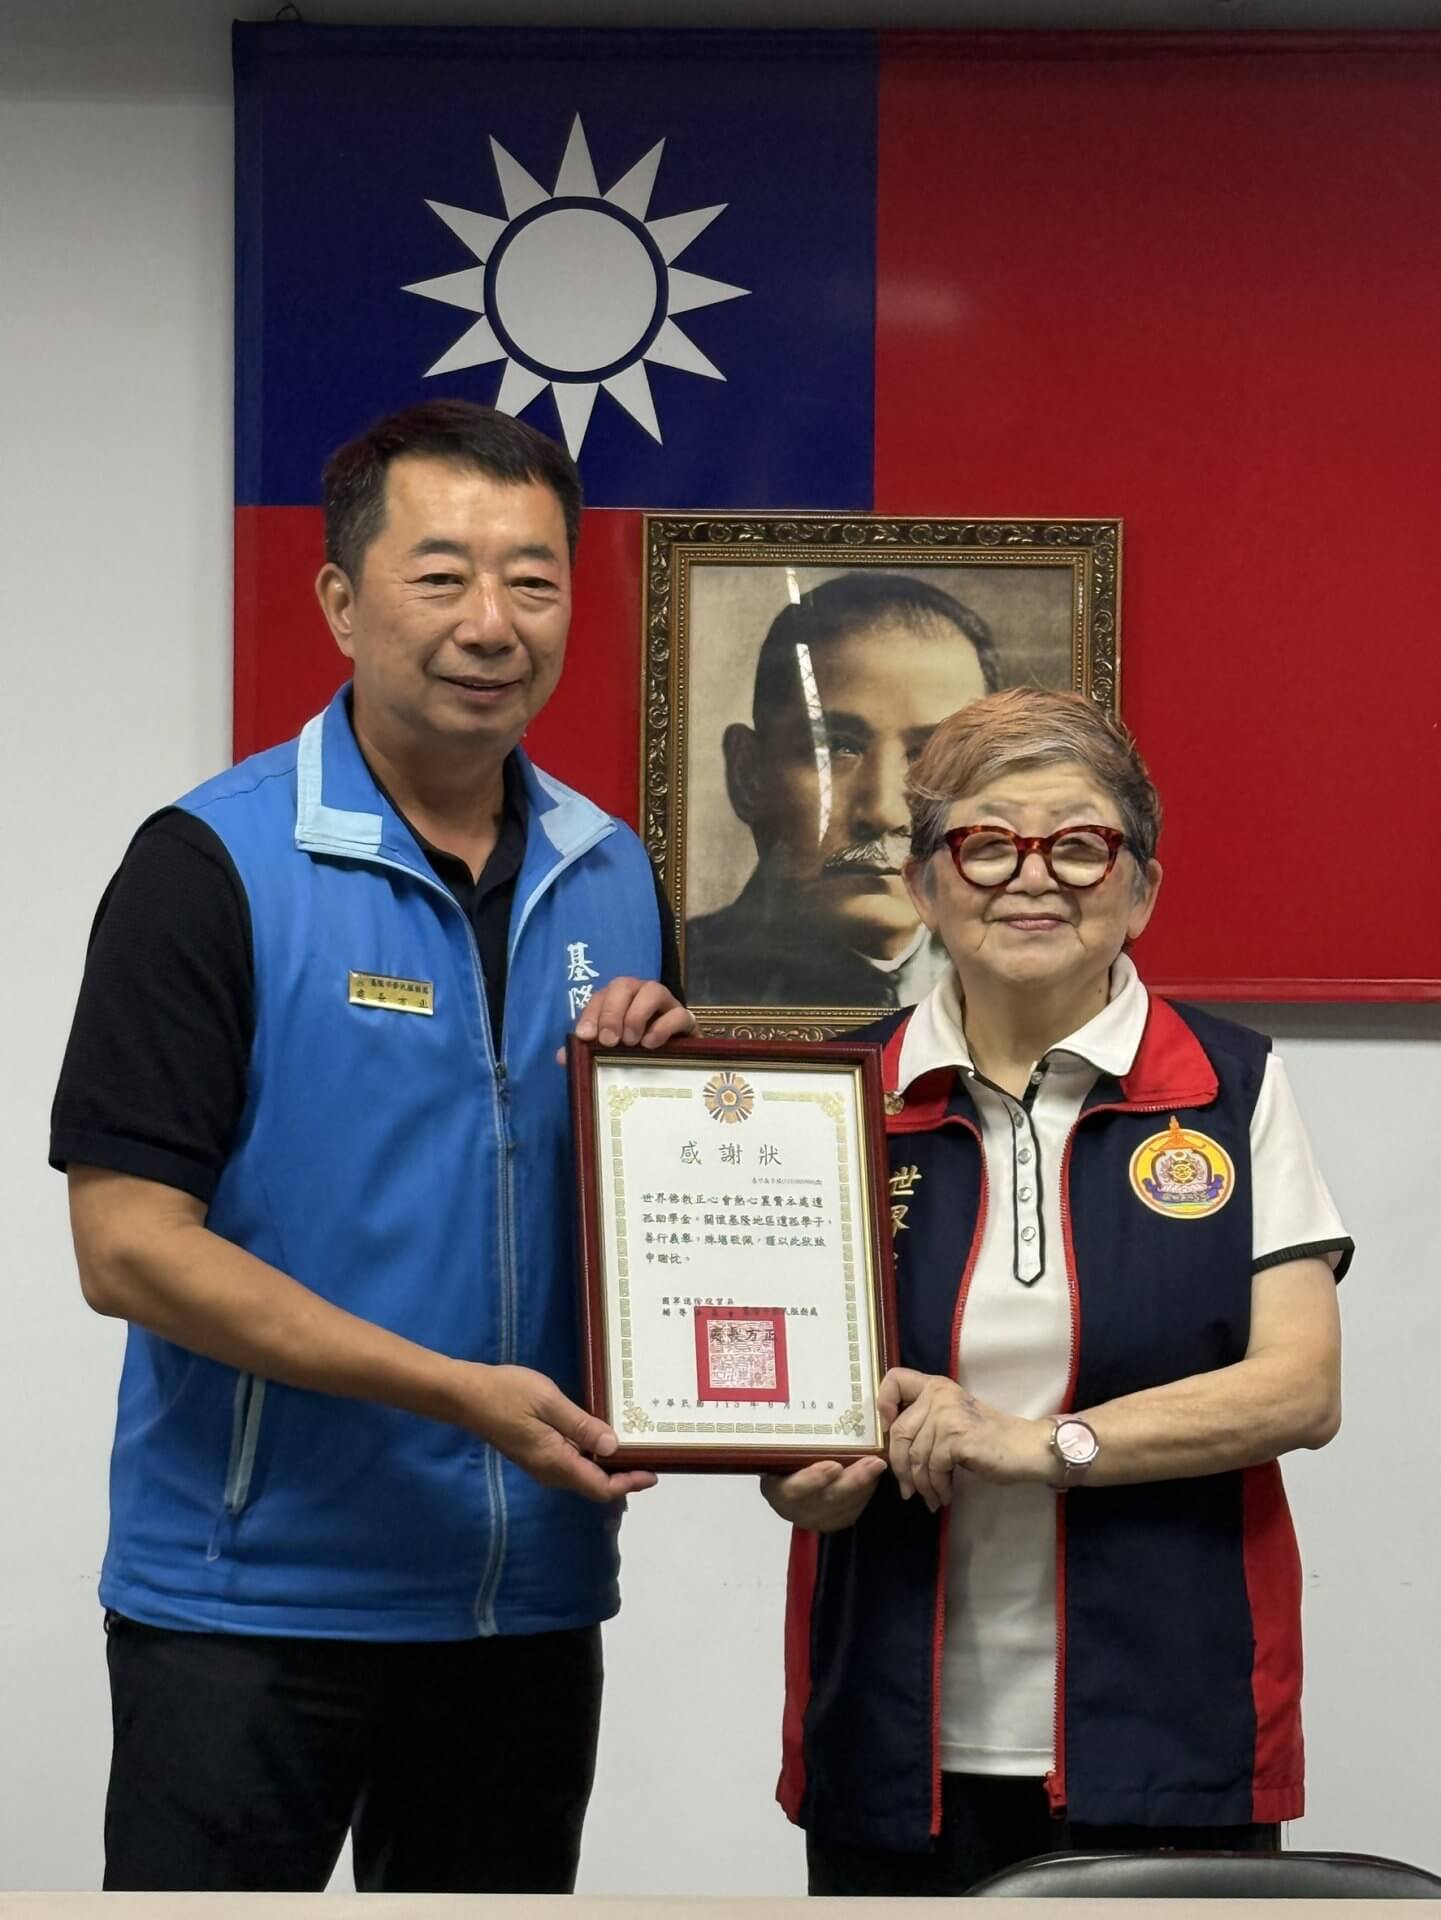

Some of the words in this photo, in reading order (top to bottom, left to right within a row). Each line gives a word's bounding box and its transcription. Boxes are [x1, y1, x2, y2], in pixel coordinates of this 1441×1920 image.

[567, 942, 600, 1020] 基隆
[680, 1140, 783, 1166] 感謝狀
[889, 1165, 922, 1270] 世界
